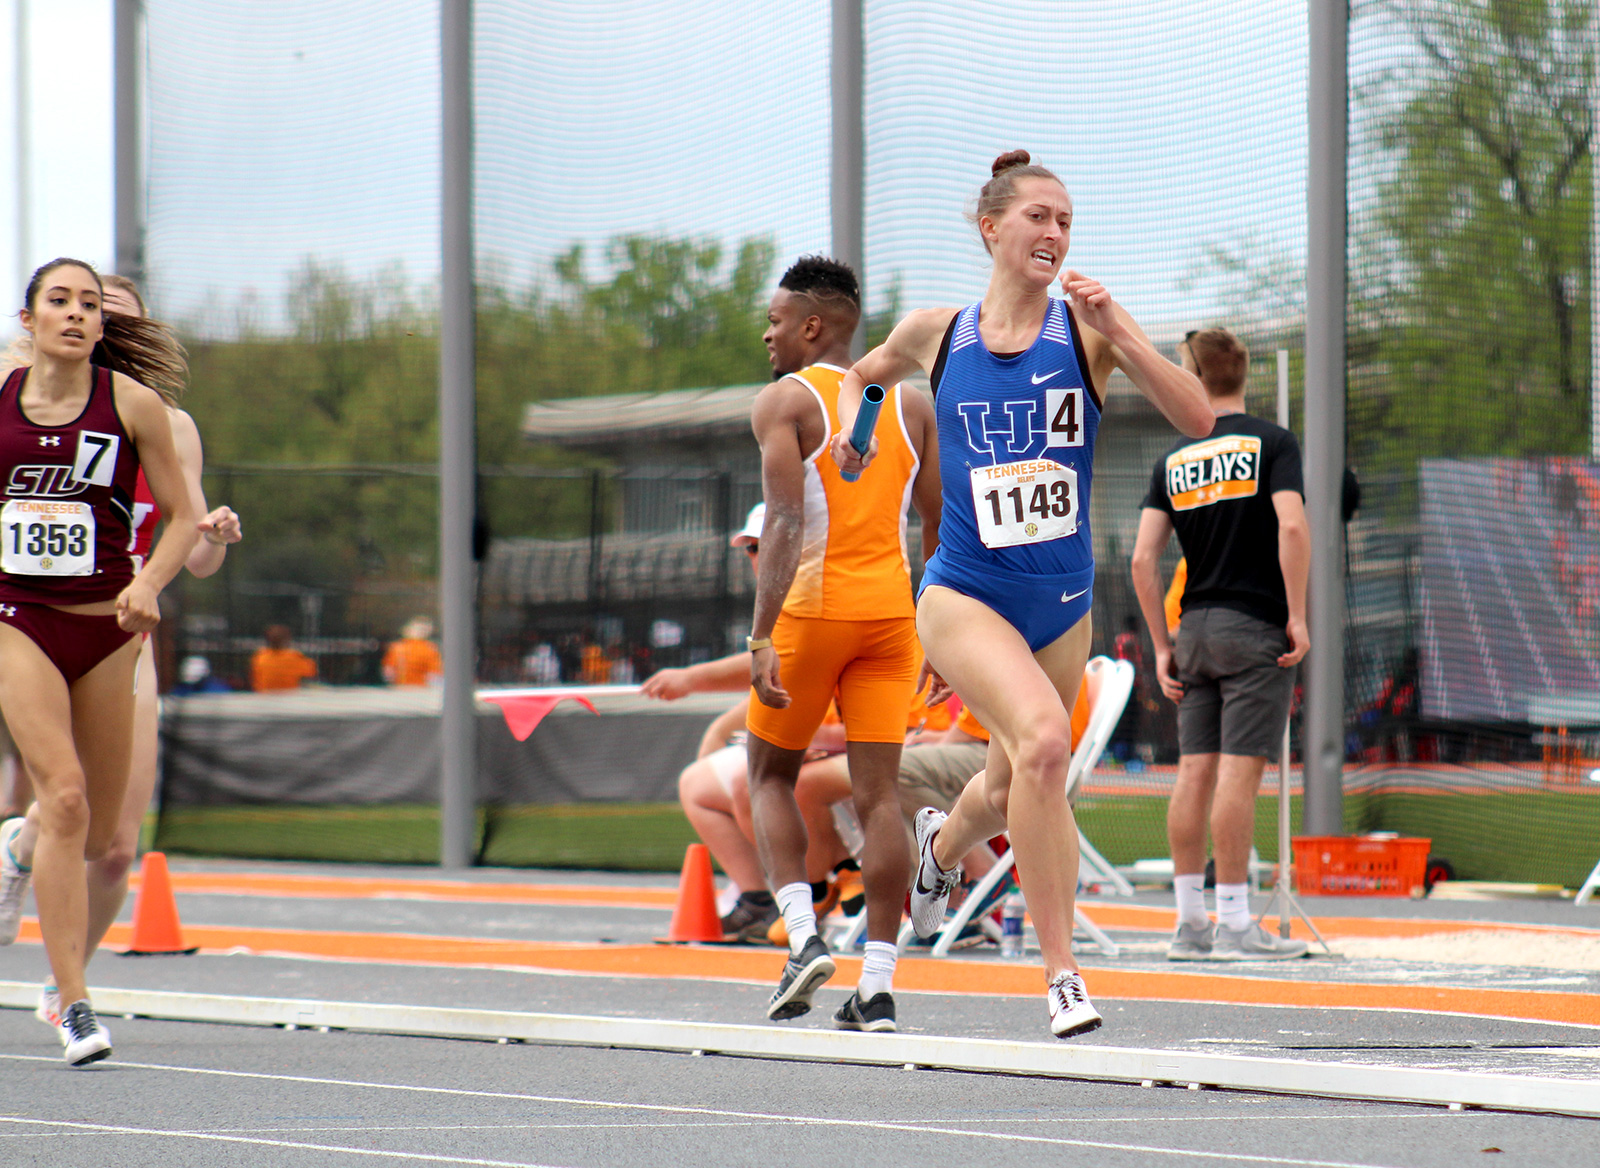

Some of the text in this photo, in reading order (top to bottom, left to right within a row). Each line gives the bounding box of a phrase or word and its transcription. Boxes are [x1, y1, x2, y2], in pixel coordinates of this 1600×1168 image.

[1051, 392, 1079, 443] 4
[83, 435, 112, 480] 7
[985, 461, 1063, 480] TENNESSEE
[1170, 452, 1252, 494] RELAYS
[15, 502, 83, 514] TENNESSEE
[985, 480, 1071, 526] 1143
[10, 522, 88, 557] 1353
